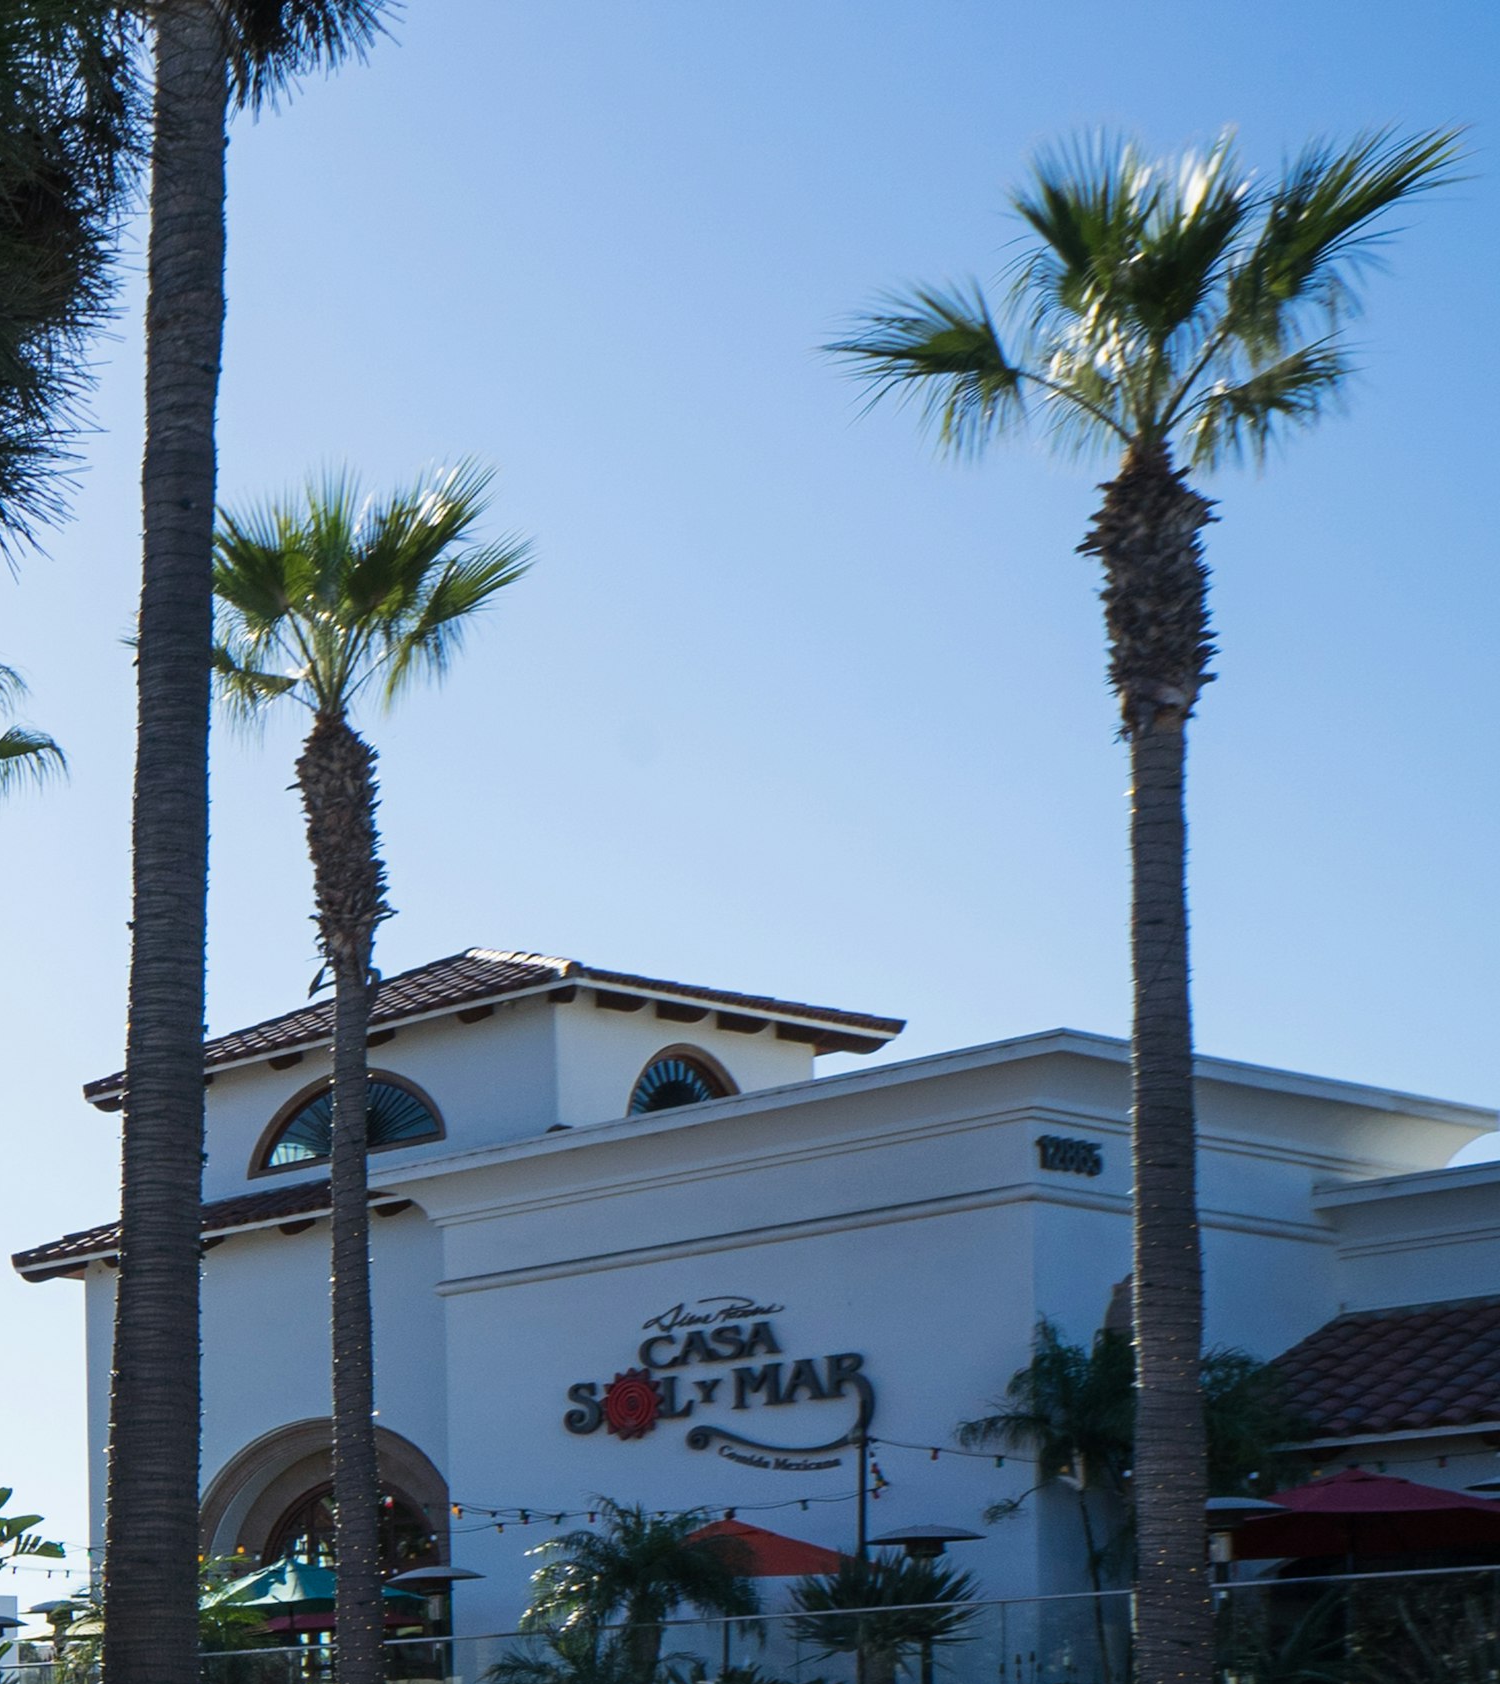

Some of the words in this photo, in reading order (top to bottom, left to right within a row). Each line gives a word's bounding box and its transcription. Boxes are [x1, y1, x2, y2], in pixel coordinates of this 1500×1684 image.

[639, 1321, 785, 1370] CASA
[564, 1367, 694, 1440] SOL
[693, 1378, 723, 1404] Y
[731, 1352, 872, 1410] MAR
[772, 1456, 842, 1471] Mexicana
